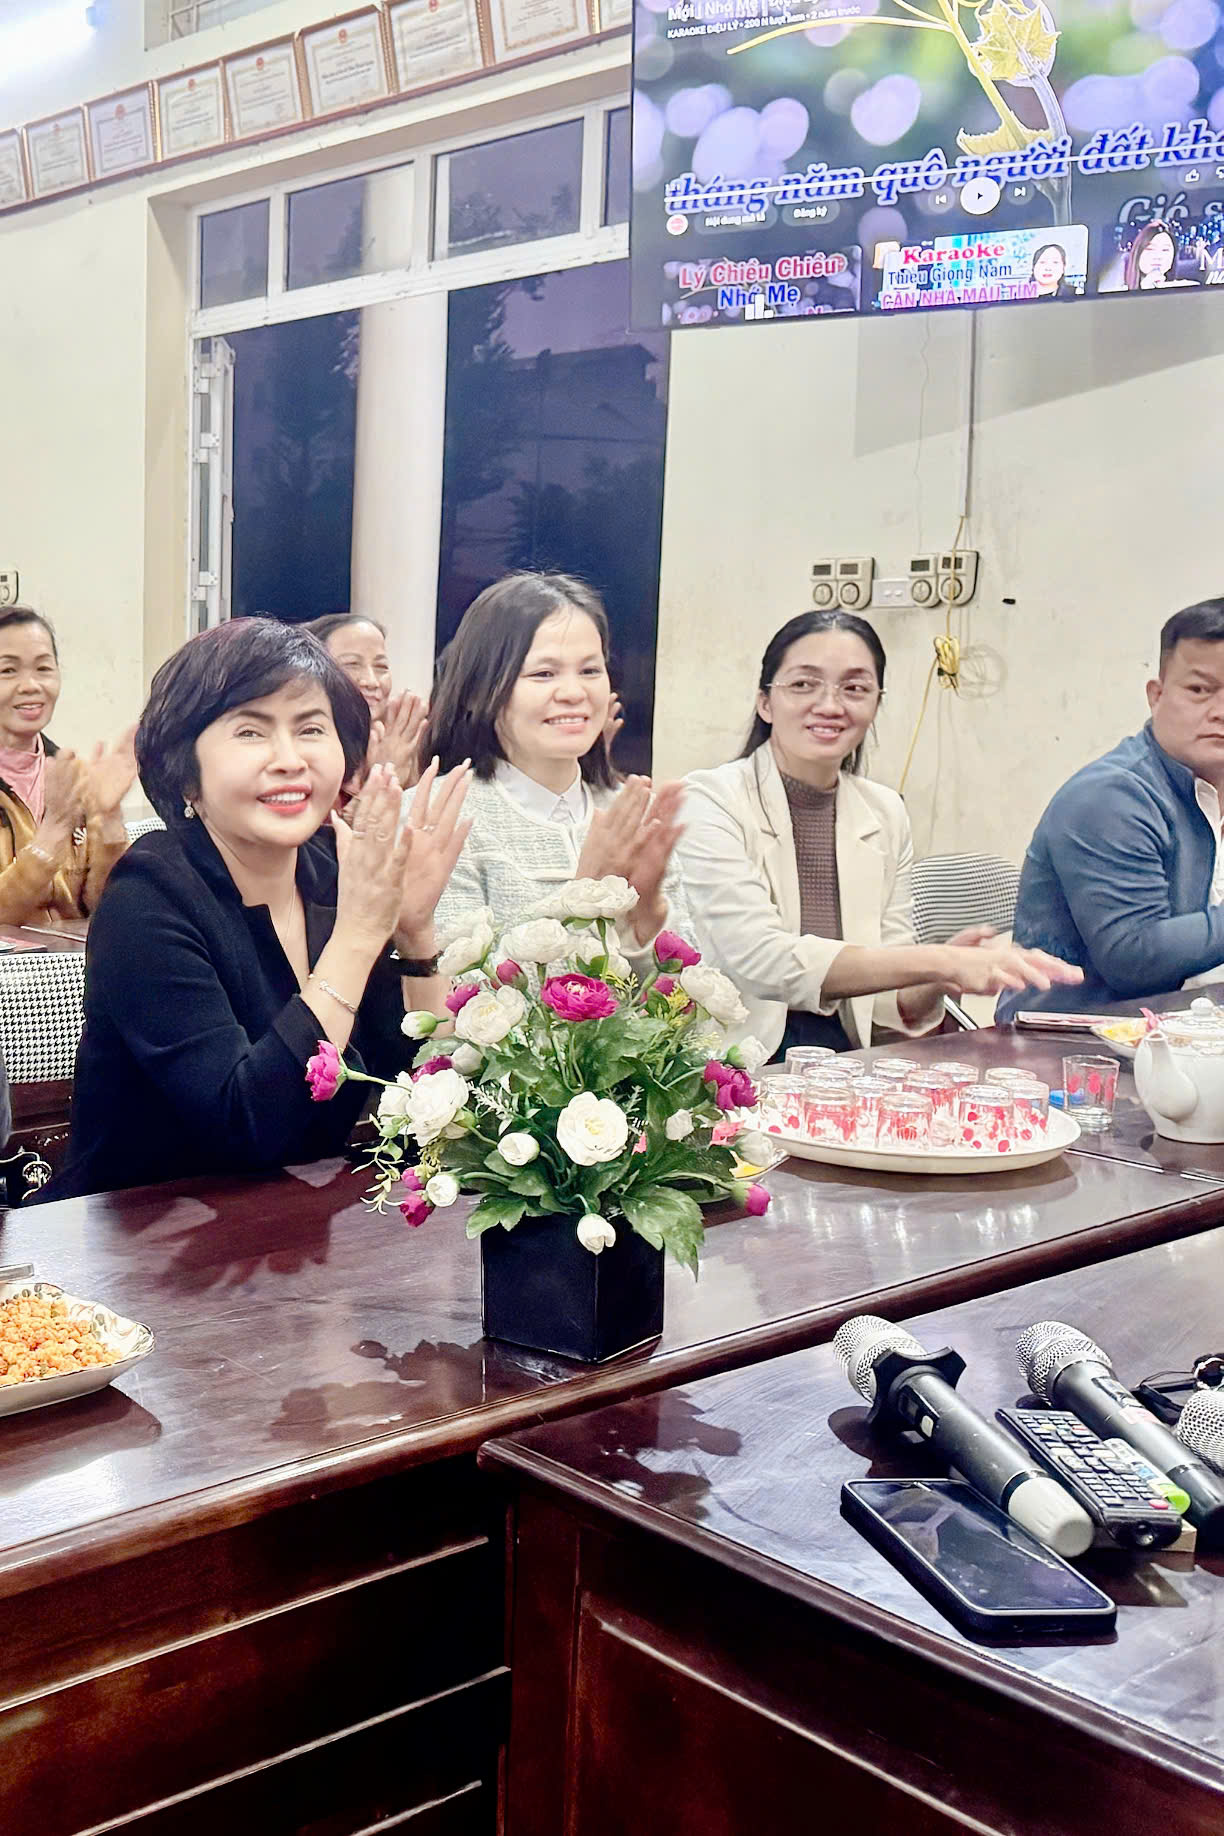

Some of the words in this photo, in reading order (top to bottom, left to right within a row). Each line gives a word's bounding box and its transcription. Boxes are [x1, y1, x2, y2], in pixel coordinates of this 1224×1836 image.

[666, 25, 707, 38] KARAOKE
[667, 174, 769, 215] tháng
[777, 165, 863, 202] năm
[874, 151, 946, 203] quê
[955, 138, 1070, 187] người
[1081, 124, 1152, 171] đất
[903, 243, 1006, 265] Karaoke
[681, 265, 704, 288] Lý
[712, 258, 771, 283] Chiều
[778, 253, 837, 279] Chiều
[980, 264, 1013, 278] Nam
[768, 284, 800, 307] Mẹ
